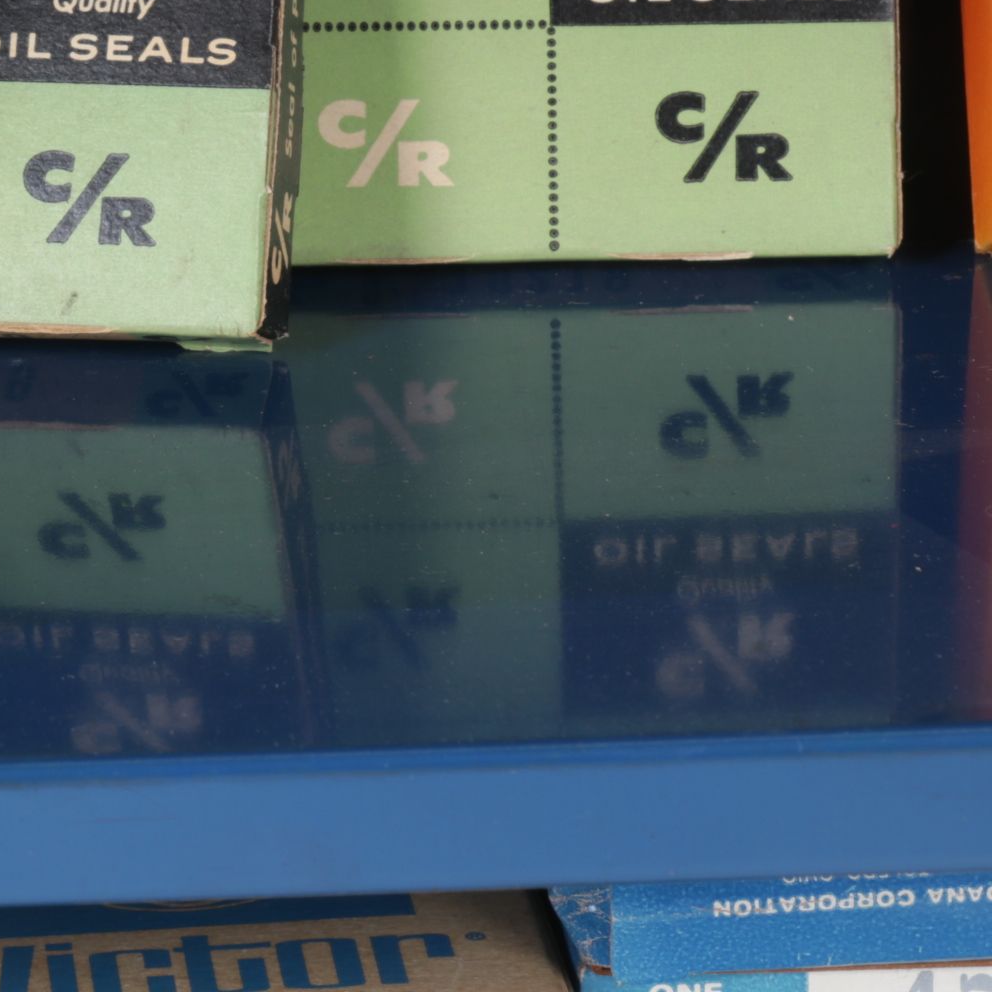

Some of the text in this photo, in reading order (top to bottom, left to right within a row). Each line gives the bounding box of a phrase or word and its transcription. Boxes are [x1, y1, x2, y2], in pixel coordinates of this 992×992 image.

[69, 33, 238, 66] SEALS
[289, 27, 299, 69] of
[283, 81, 297, 159] Seal
[317, 98, 455, 188] C/R
[655, 90, 794, 183] C/R
[22, 148, 158, 248] C/R
[713, 888, 916, 918] CORPORATION
